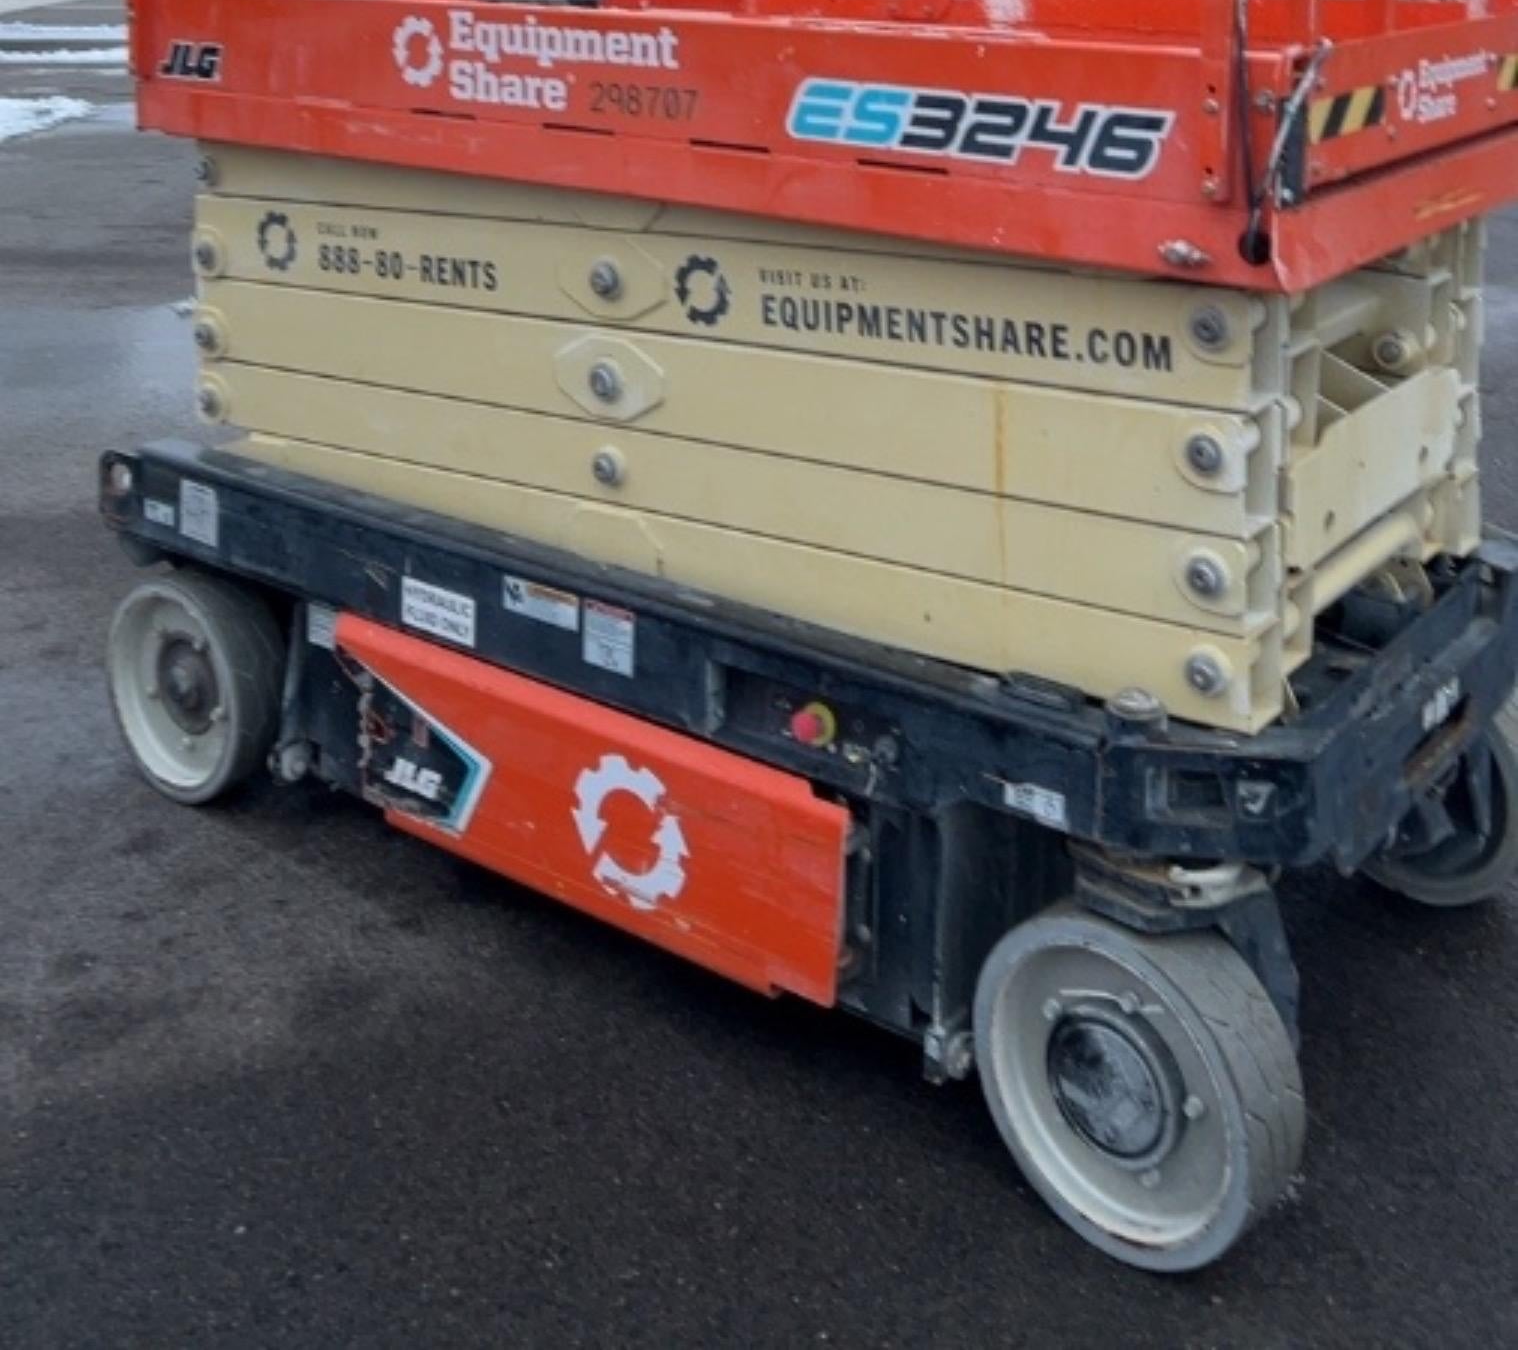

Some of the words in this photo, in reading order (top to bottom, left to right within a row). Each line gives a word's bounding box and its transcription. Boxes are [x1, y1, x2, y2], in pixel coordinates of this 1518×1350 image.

[157, 41, 222, 80] JLG
[448, 10, 679, 69] Equipment
[450, 59, 568, 111] Share
[589, 80, 698, 121] 298707
[788, 79, 1173, 177] ES3246
[318, 243, 498, 292] 888-80-RENTS
[758, 267, 803, 287] VISIT
[810, 272, 832, 290] US
[761, 293, 1173, 371] EQUIPMENTSHARE.COM
